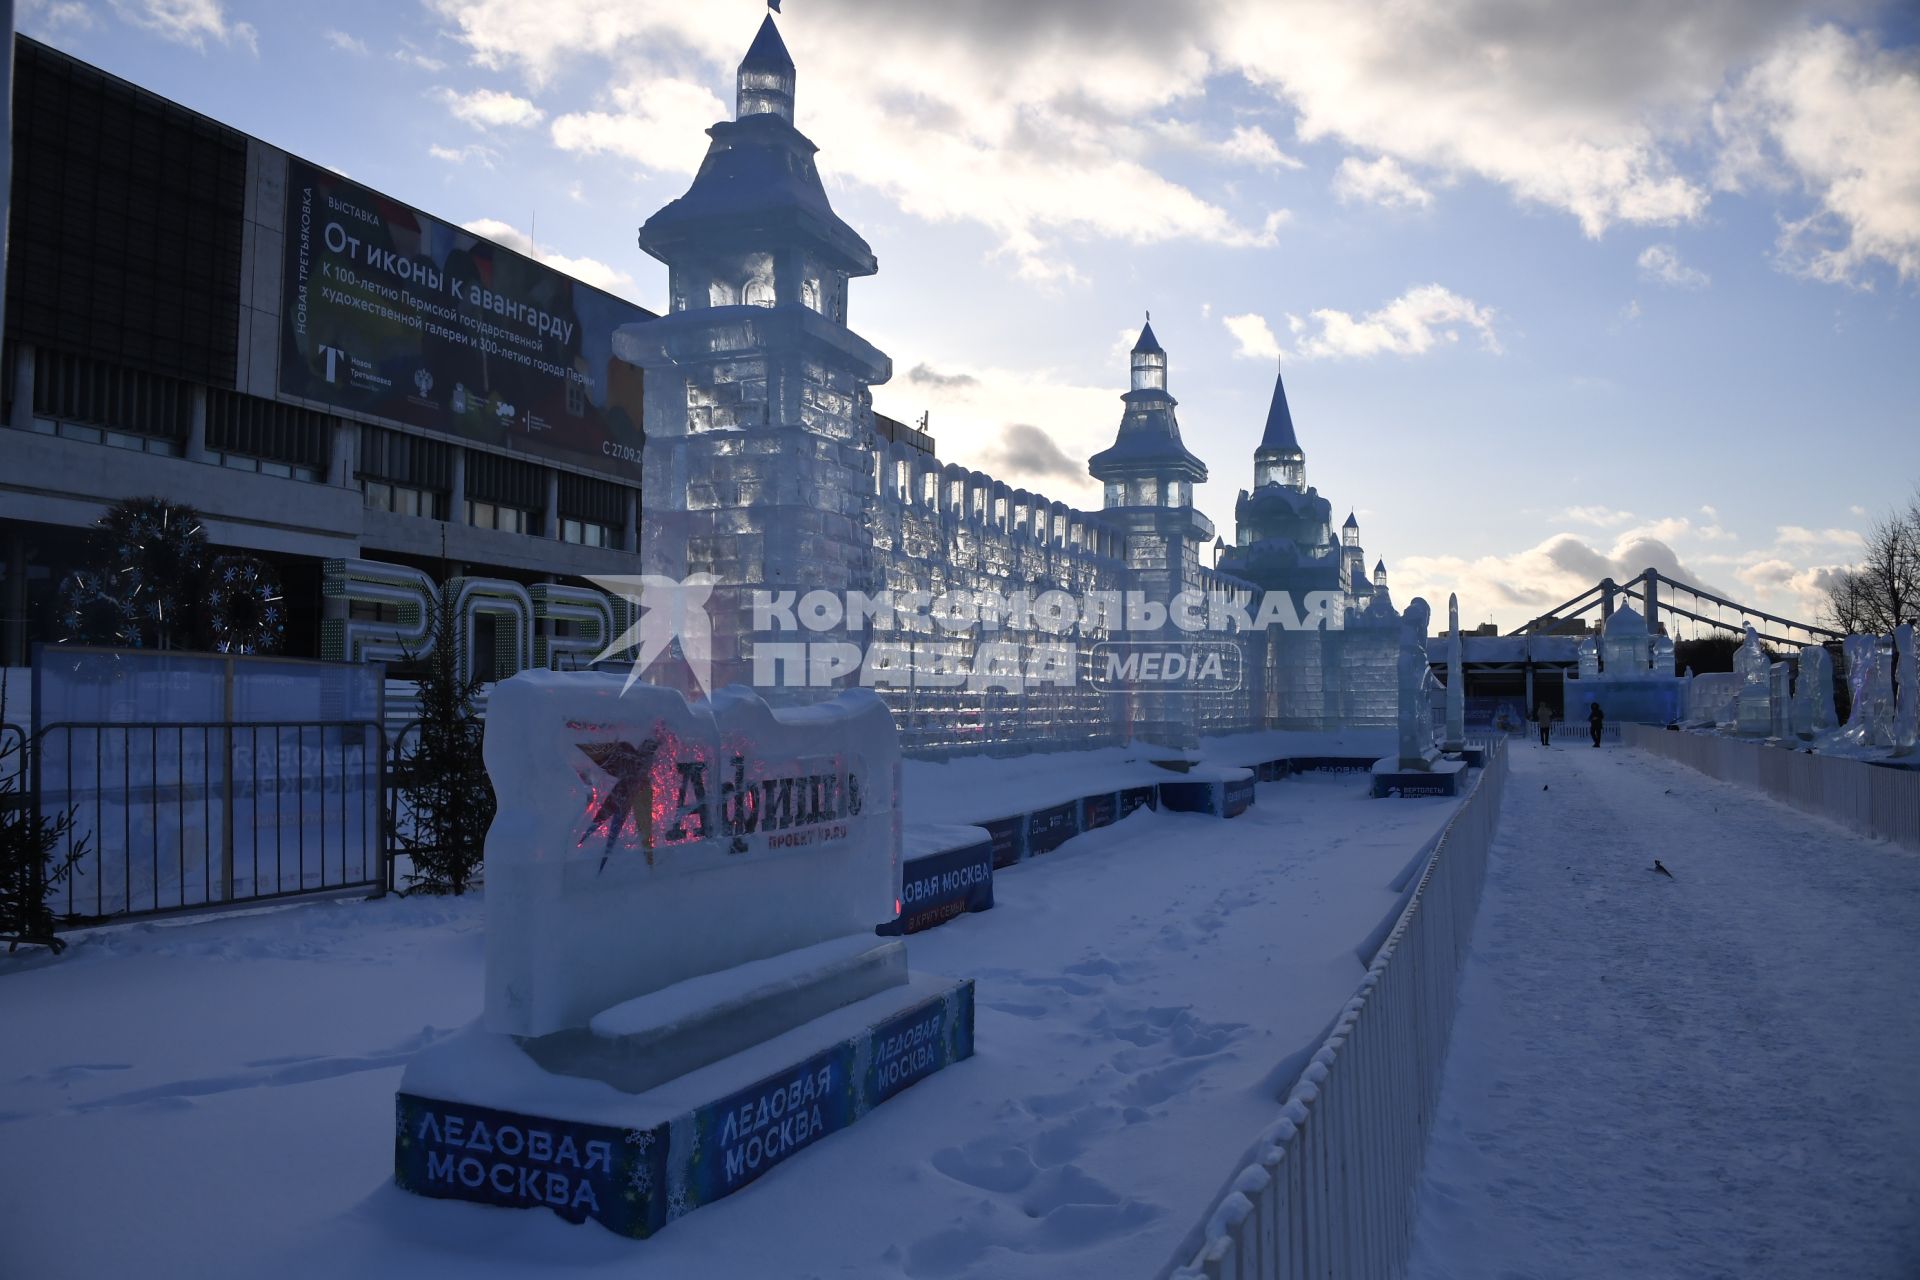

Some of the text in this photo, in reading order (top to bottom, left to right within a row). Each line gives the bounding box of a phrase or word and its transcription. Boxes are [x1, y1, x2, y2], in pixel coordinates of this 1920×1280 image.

[327, 196, 380, 227] ВЫСТАВКА
[296, 187, 313, 335] НОВАЯ ТРЕТЬЯКОВКА
[324, 222, 361, 260] От
[367, 243, 444, 292] иконы
[470, 285, 574, 345] авангарду
[321, 286, 596, 388] художественной галереи и 300-летию города Перми
[322, 261, 544, 352] К 100-летию Пермской государственной
[602, 440, 610, 455] С
[902, 862, 989, 903] ОВАЯ МОСКВА
[875, 1014, 940, 1066] ЛЕДОВАЯ
[878, 1043, 935, 1092] МОСКВА
[720, 1064, 831, 1147] ЛЕДОВАЯ
[417, 1111, 612, 1174] ЛЕДОВАЯ
[725, 1103, 824, 1183] МОСКВА
[426, 1150, 600, 1212] МОСКВА
